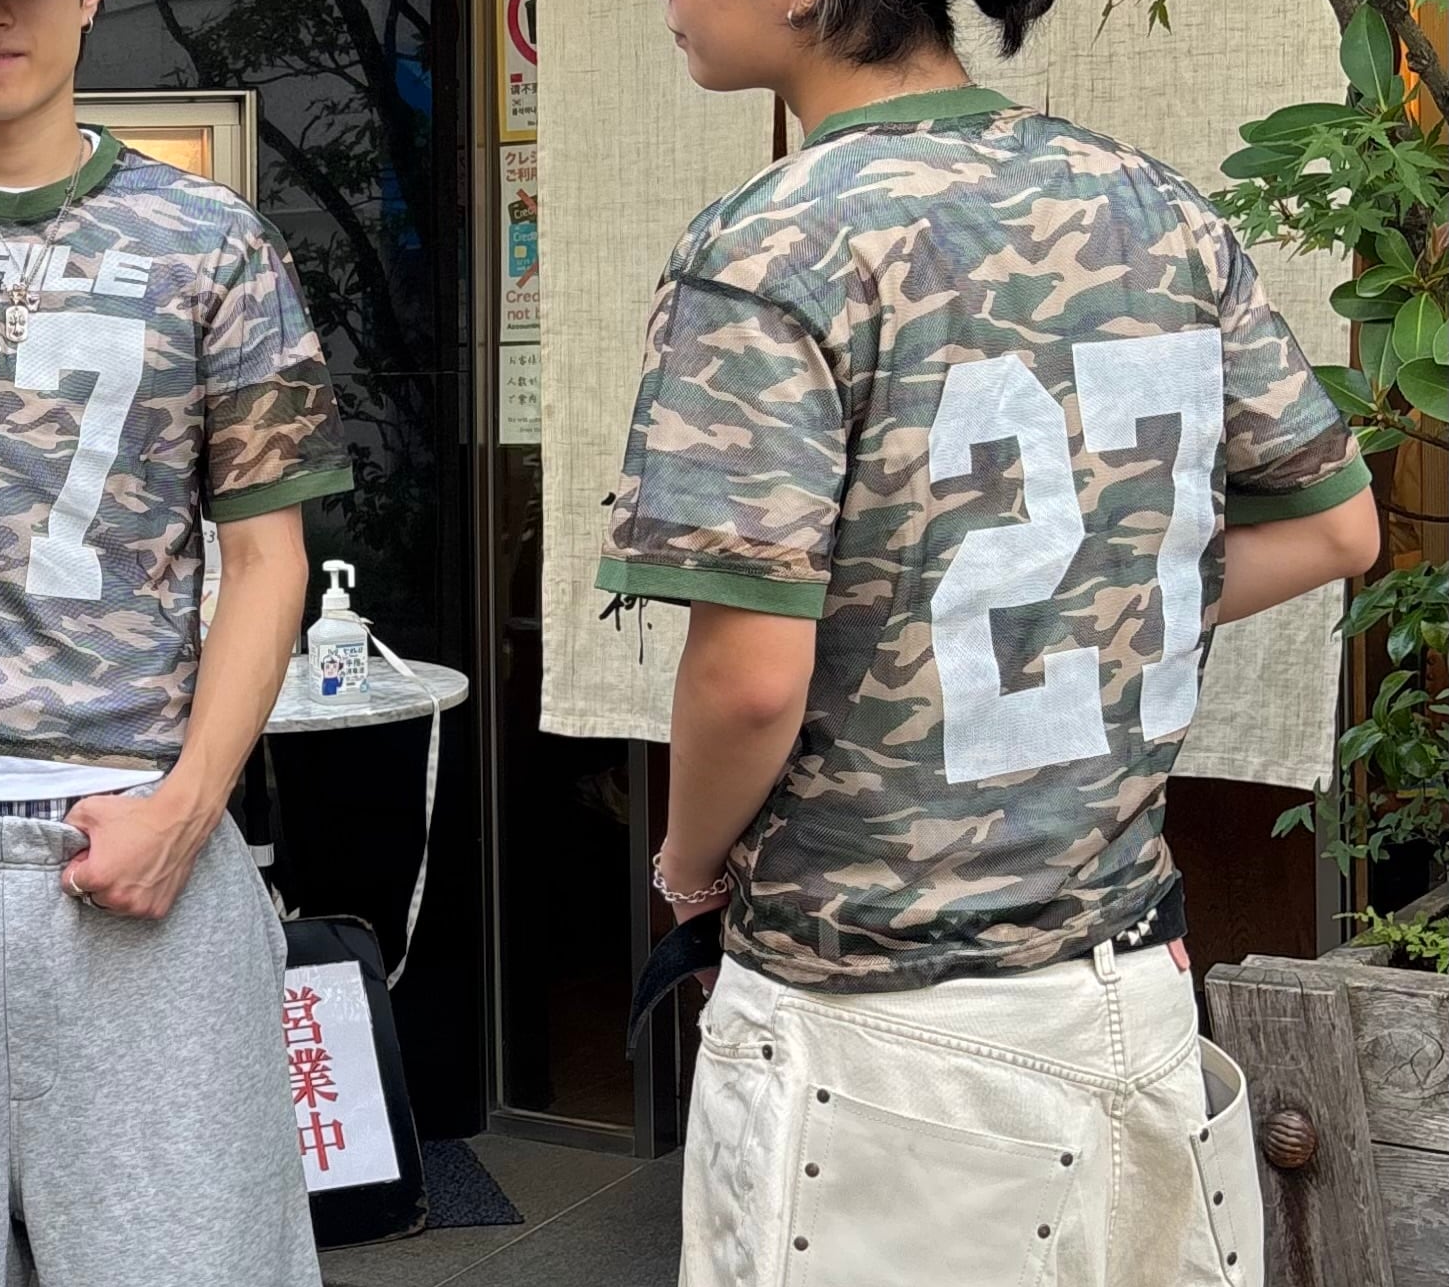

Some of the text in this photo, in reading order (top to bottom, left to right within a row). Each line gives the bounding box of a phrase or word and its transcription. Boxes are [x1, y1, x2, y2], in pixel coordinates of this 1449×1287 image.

[928, 327, 1224, 784] 27
[282, 986, 345, 1172] 営業中
